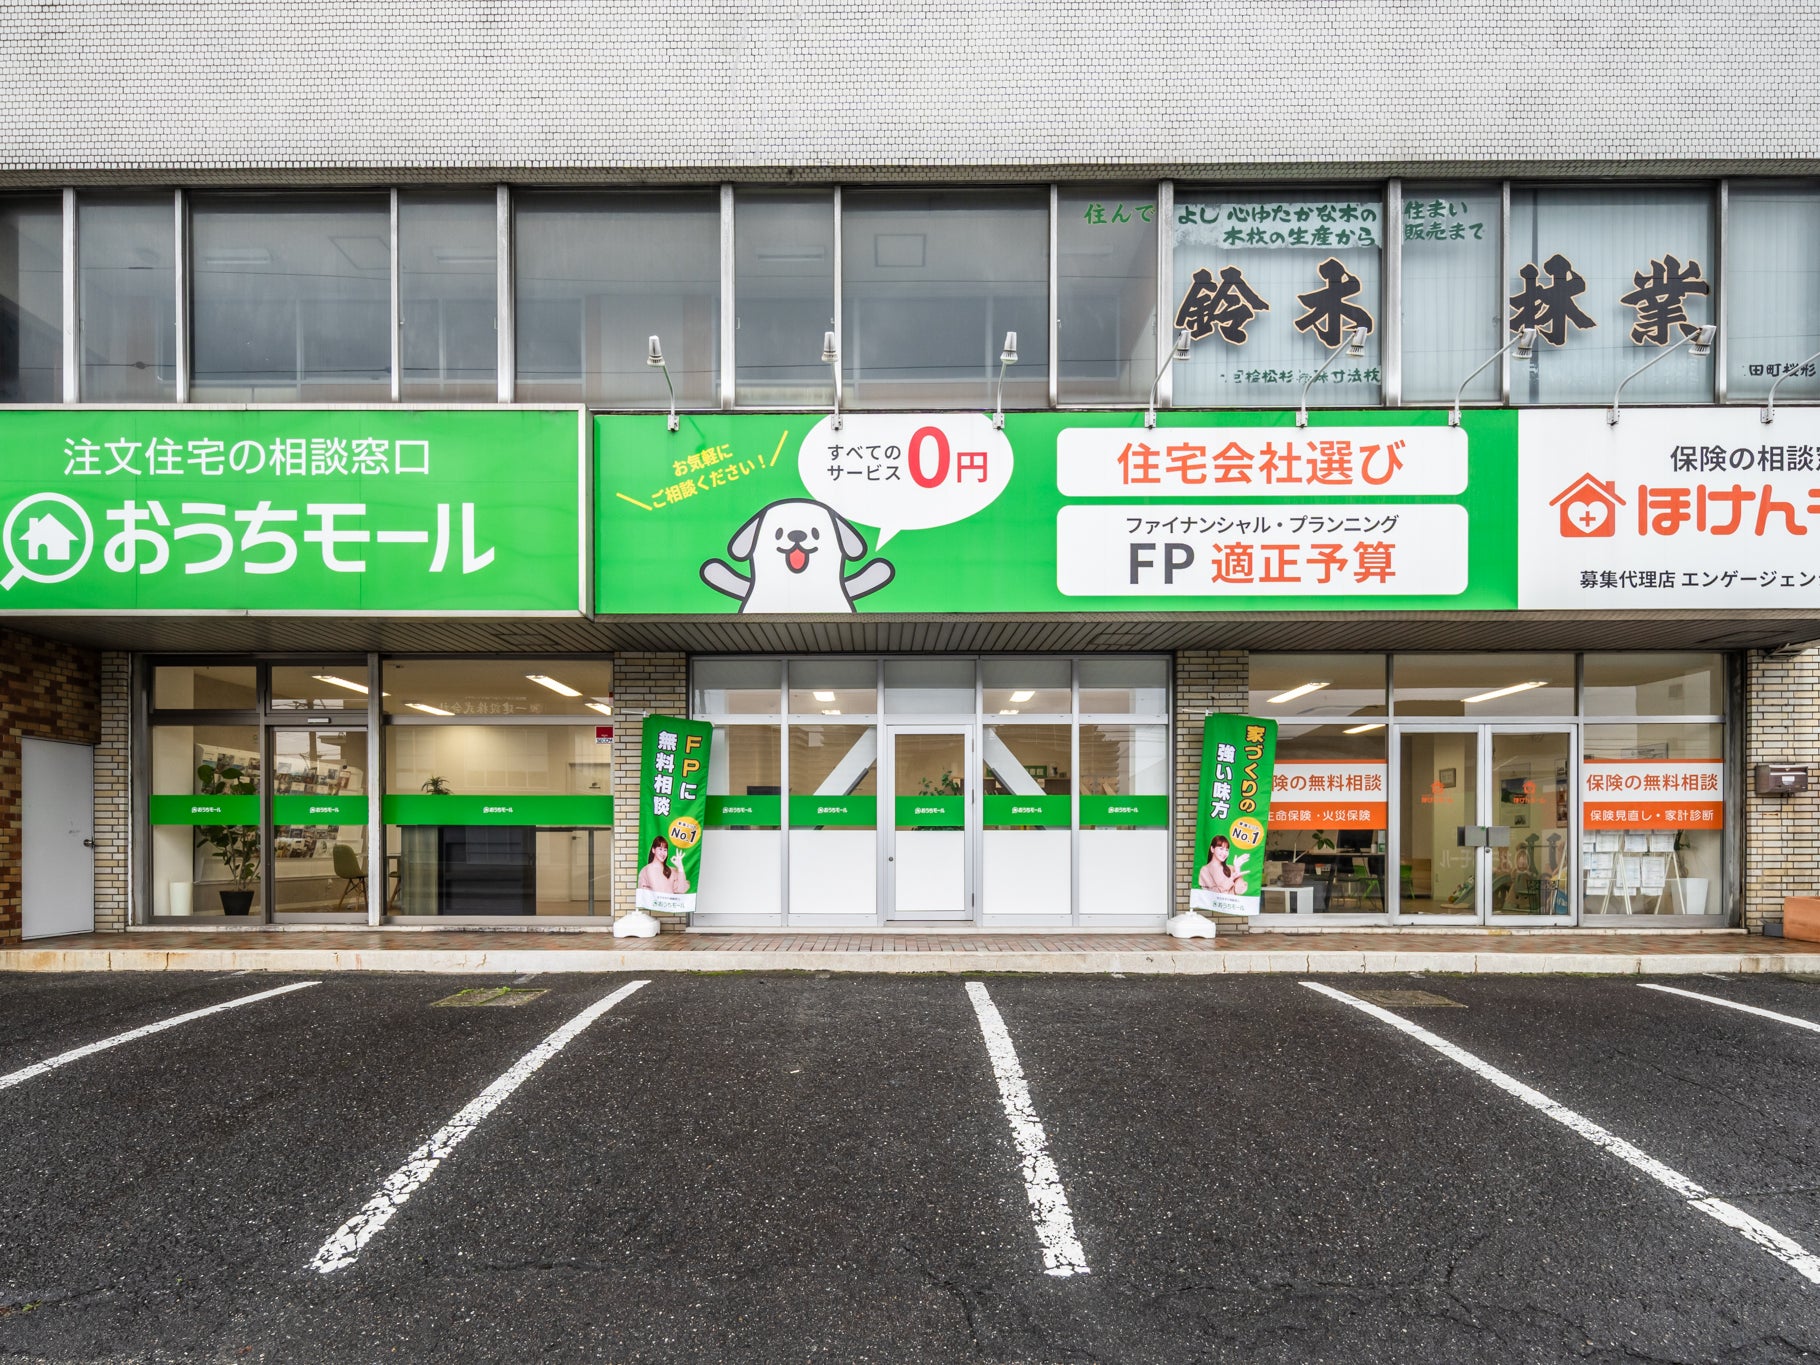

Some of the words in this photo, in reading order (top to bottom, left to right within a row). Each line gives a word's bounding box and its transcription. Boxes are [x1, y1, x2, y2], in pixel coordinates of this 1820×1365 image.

[1083, 203, 1154, 225] 住んで
[1404, 199, 1468, 220] 住まい
[1404, 221, 1484, 241] 販売まで
[64, 436, 430, 476] 注文住宅の相談窓口
[673, 443, 733, 477] お気軽に
[827, 444, 901, 461] すべての
[907, 426, 988, 489] 0円
[1117, 439, 1406, 486] 住宅会社選び
[1670, 444, 1820, 472] 保険の相談
[827, 464, 901, 481] サービス
[103, 499, 495, 575] おうちモール
[1126, 514, 1399, 535] ファイナンシャル・プランニング
[1130, 543, 1195, 585] FP
[1211, 541, 1396, 585] 適正予算
[1580, 570, 1676, 589] 募集代理店
[1681, 569, 1820, 588] エンゲージェン
[653, 731, 678, 816] 無料相談
[679, 735, 702, 800] FPに
[1211, 743, 1237, 820] 強い味方
[1239, 725, 1266, 813] 家づくりの
[1272, 774, 1382, 791] 険の無料相談
[1586, 773, 1718, 791] 保険の無料相談
[1590, 809, 1714, 822] 保険見直し・家計診断
[1232, 827, 1260, 844] No.1
